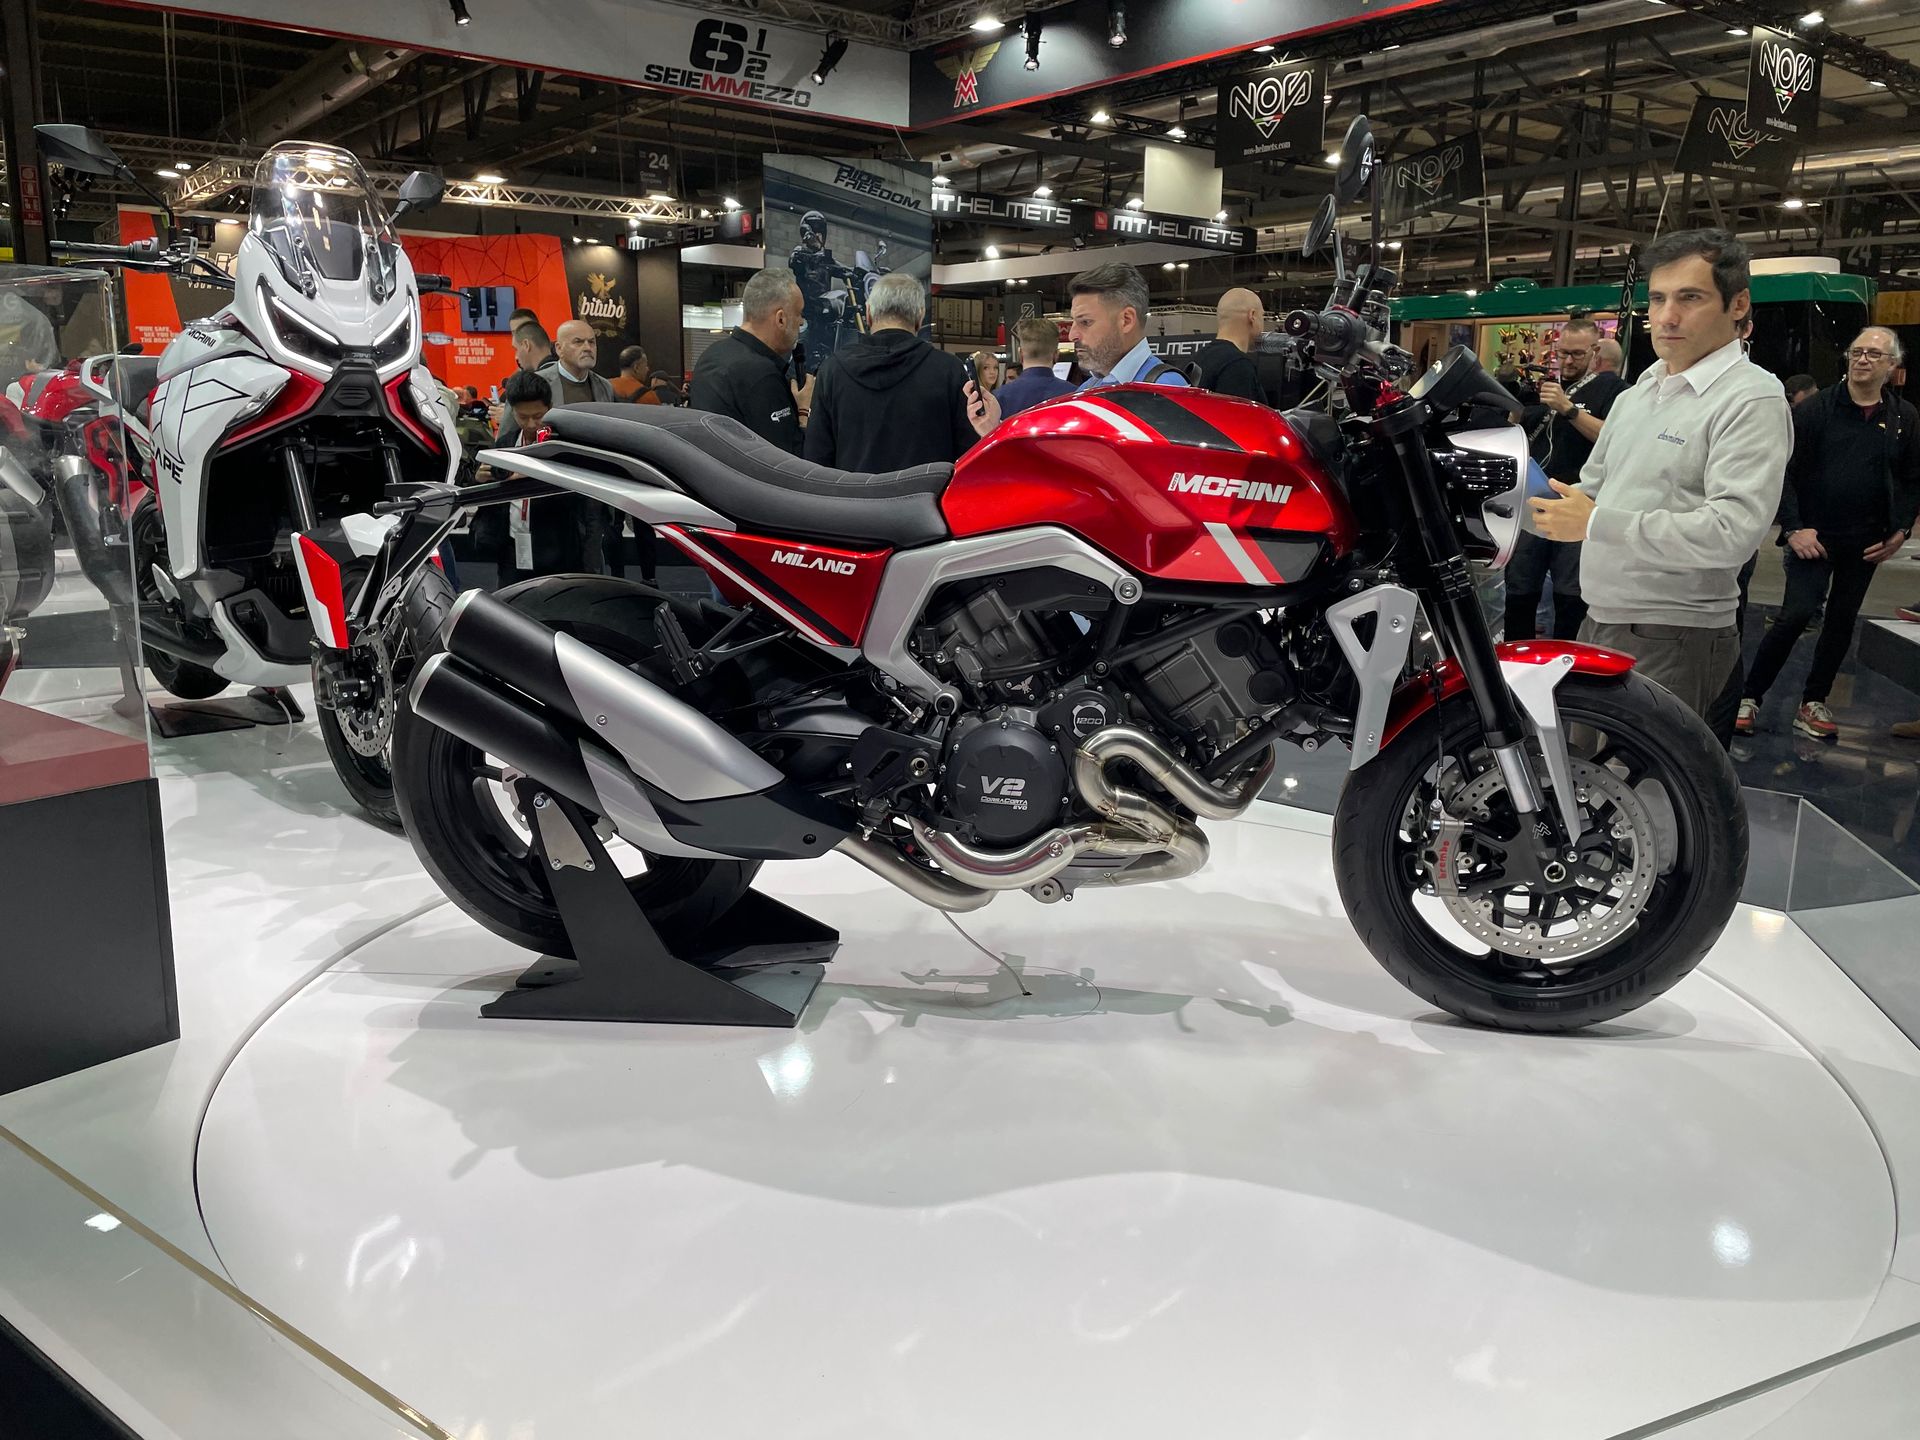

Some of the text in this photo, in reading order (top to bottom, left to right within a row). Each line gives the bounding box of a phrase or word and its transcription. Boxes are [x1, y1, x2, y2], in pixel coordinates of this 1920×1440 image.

[644, 63, 812, 108] SEIEMMEZZO
[648, 152, 670, 170] 24
[833, 176, 922, 210] FREEDOM
[1346, 243, 1357, 256] 24
[580, 296, 625, 319] bitubo
[1177, 472, 1293, 504] MORINI
[770, 549, 857, 576] MILANO
[1076, 717, 1103, 725] 1200
[980, 775, 1026, 797] V2
[1438, 840, 1450, 879] brembo
